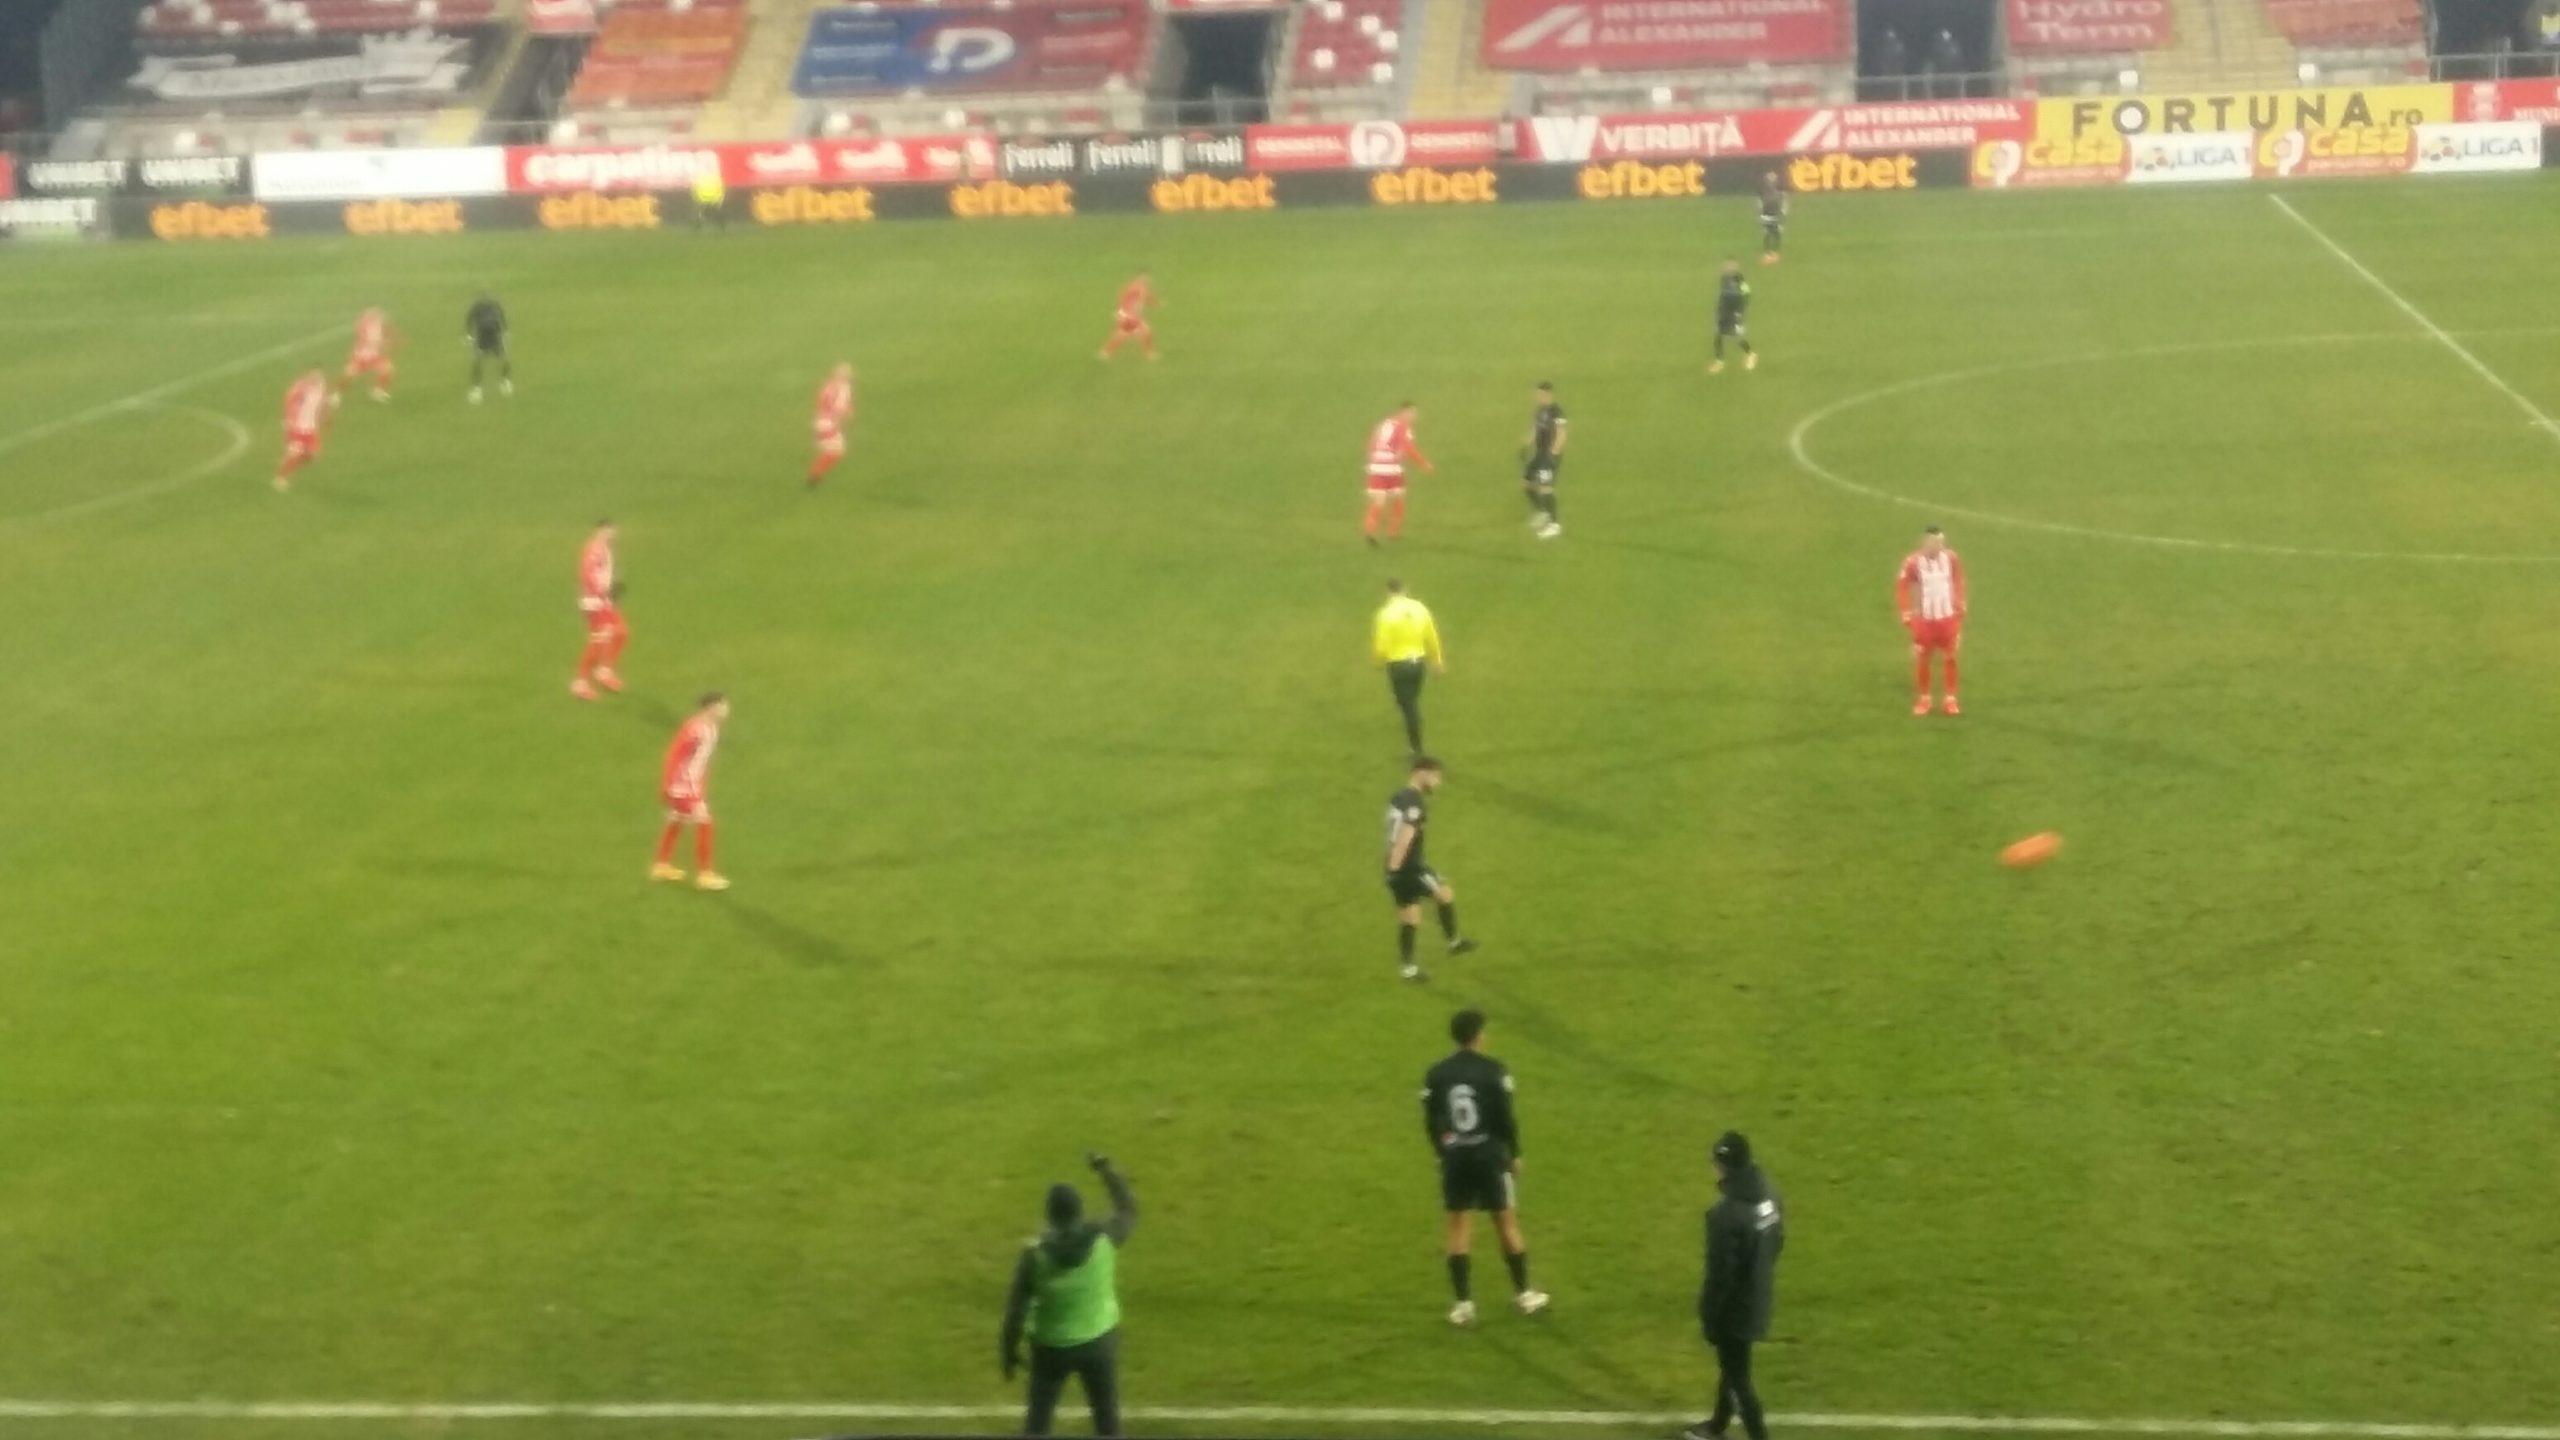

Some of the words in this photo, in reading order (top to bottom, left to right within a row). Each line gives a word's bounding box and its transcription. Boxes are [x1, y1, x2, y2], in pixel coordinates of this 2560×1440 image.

[1601, 0, 1832, 19] INTERNATIONAL
[2017, 0, 2164, 18] Hydro
[1599, 21, 1768, 44] ALEXANDER
[2026, 21, 2153, 42] Term
[1842, 103, 2021, 126] INTERNATIONAL
[1845, 126, 1977, 148] ALEXANDER
[2308, 124, 2410, 156] casa
[2463, 136, 2524, 157] LIGA
[1789, 153, 1917, 190] efbet
[2177, 146, 2239, 167] LIGA
[1152, 174, 1276, 210] efbet
[1373, 167, 1497, 203] efbet
[1580, 160, 1705, 198] efbet
[538, 191, 662, 229] efbet
[752, 185, 874, 224] efbet
[951, 180, 1074, 217] efbet
[1447, 1082, 1480, 1133] 6
